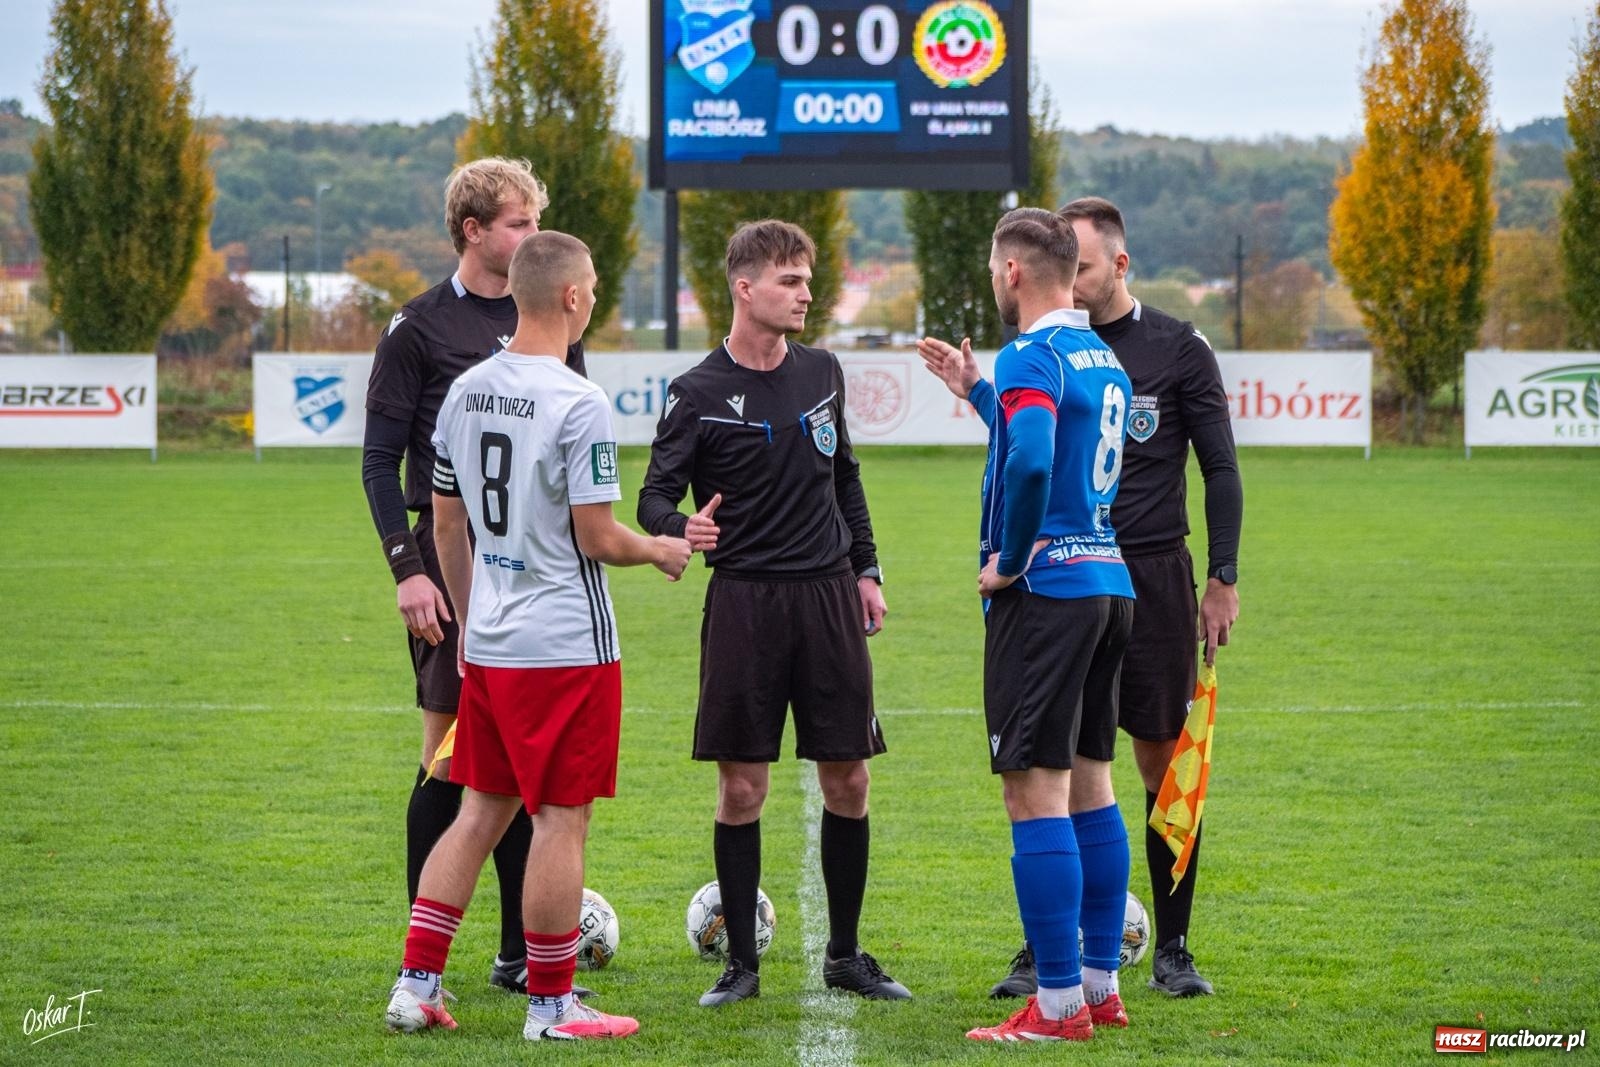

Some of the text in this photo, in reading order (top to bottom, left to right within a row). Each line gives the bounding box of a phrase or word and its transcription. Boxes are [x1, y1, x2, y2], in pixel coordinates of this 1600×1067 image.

[777, 4, 820, 66] 0
[856, 4, 900, 66] 0
[693, 99, 741, 117] UNIA
[793, 93, 884, 124] 00:00
[668, 116, 767, 137] RACIBÓRZ
[465, 393, 535, 420] UNIA TURZA
[1093, 382, 1126, 496] 8
[481, 431, 513, 537] 8
